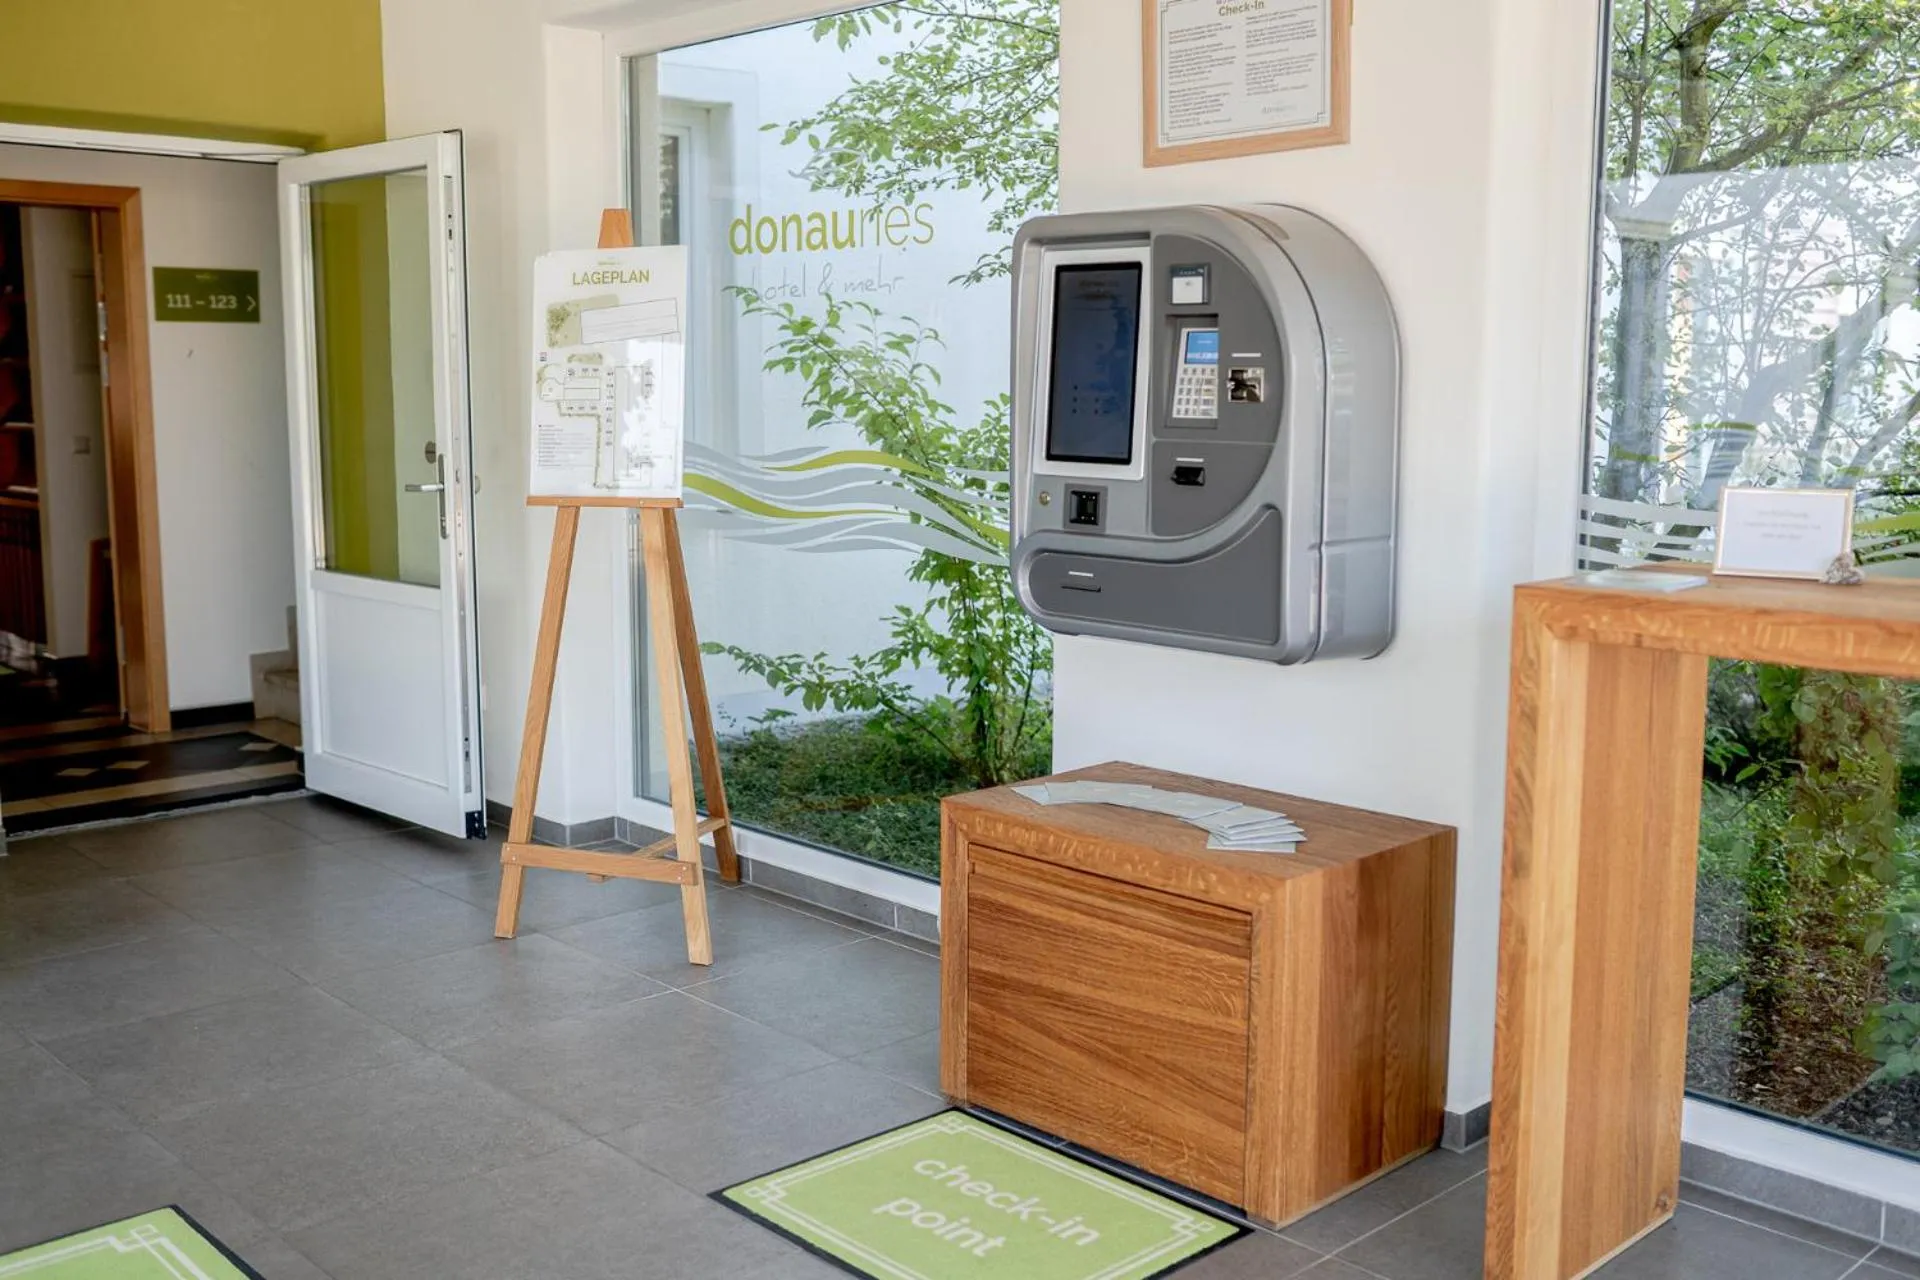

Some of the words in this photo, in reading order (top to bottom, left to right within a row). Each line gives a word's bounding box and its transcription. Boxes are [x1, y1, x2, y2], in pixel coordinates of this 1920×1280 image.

[1218, 0, 1265, 17] Check-In
[571, 268, 650, 286] LAGEPLAN
[817, 261, 833, 296] &
[844, 254, 904, 294] mehr
[166, 293, 192, 309] 111
[208, 294, 238, 309] 123
[914, 1158, 1102, 1246] check-in
[872, 1197, 1005, 1257] point
